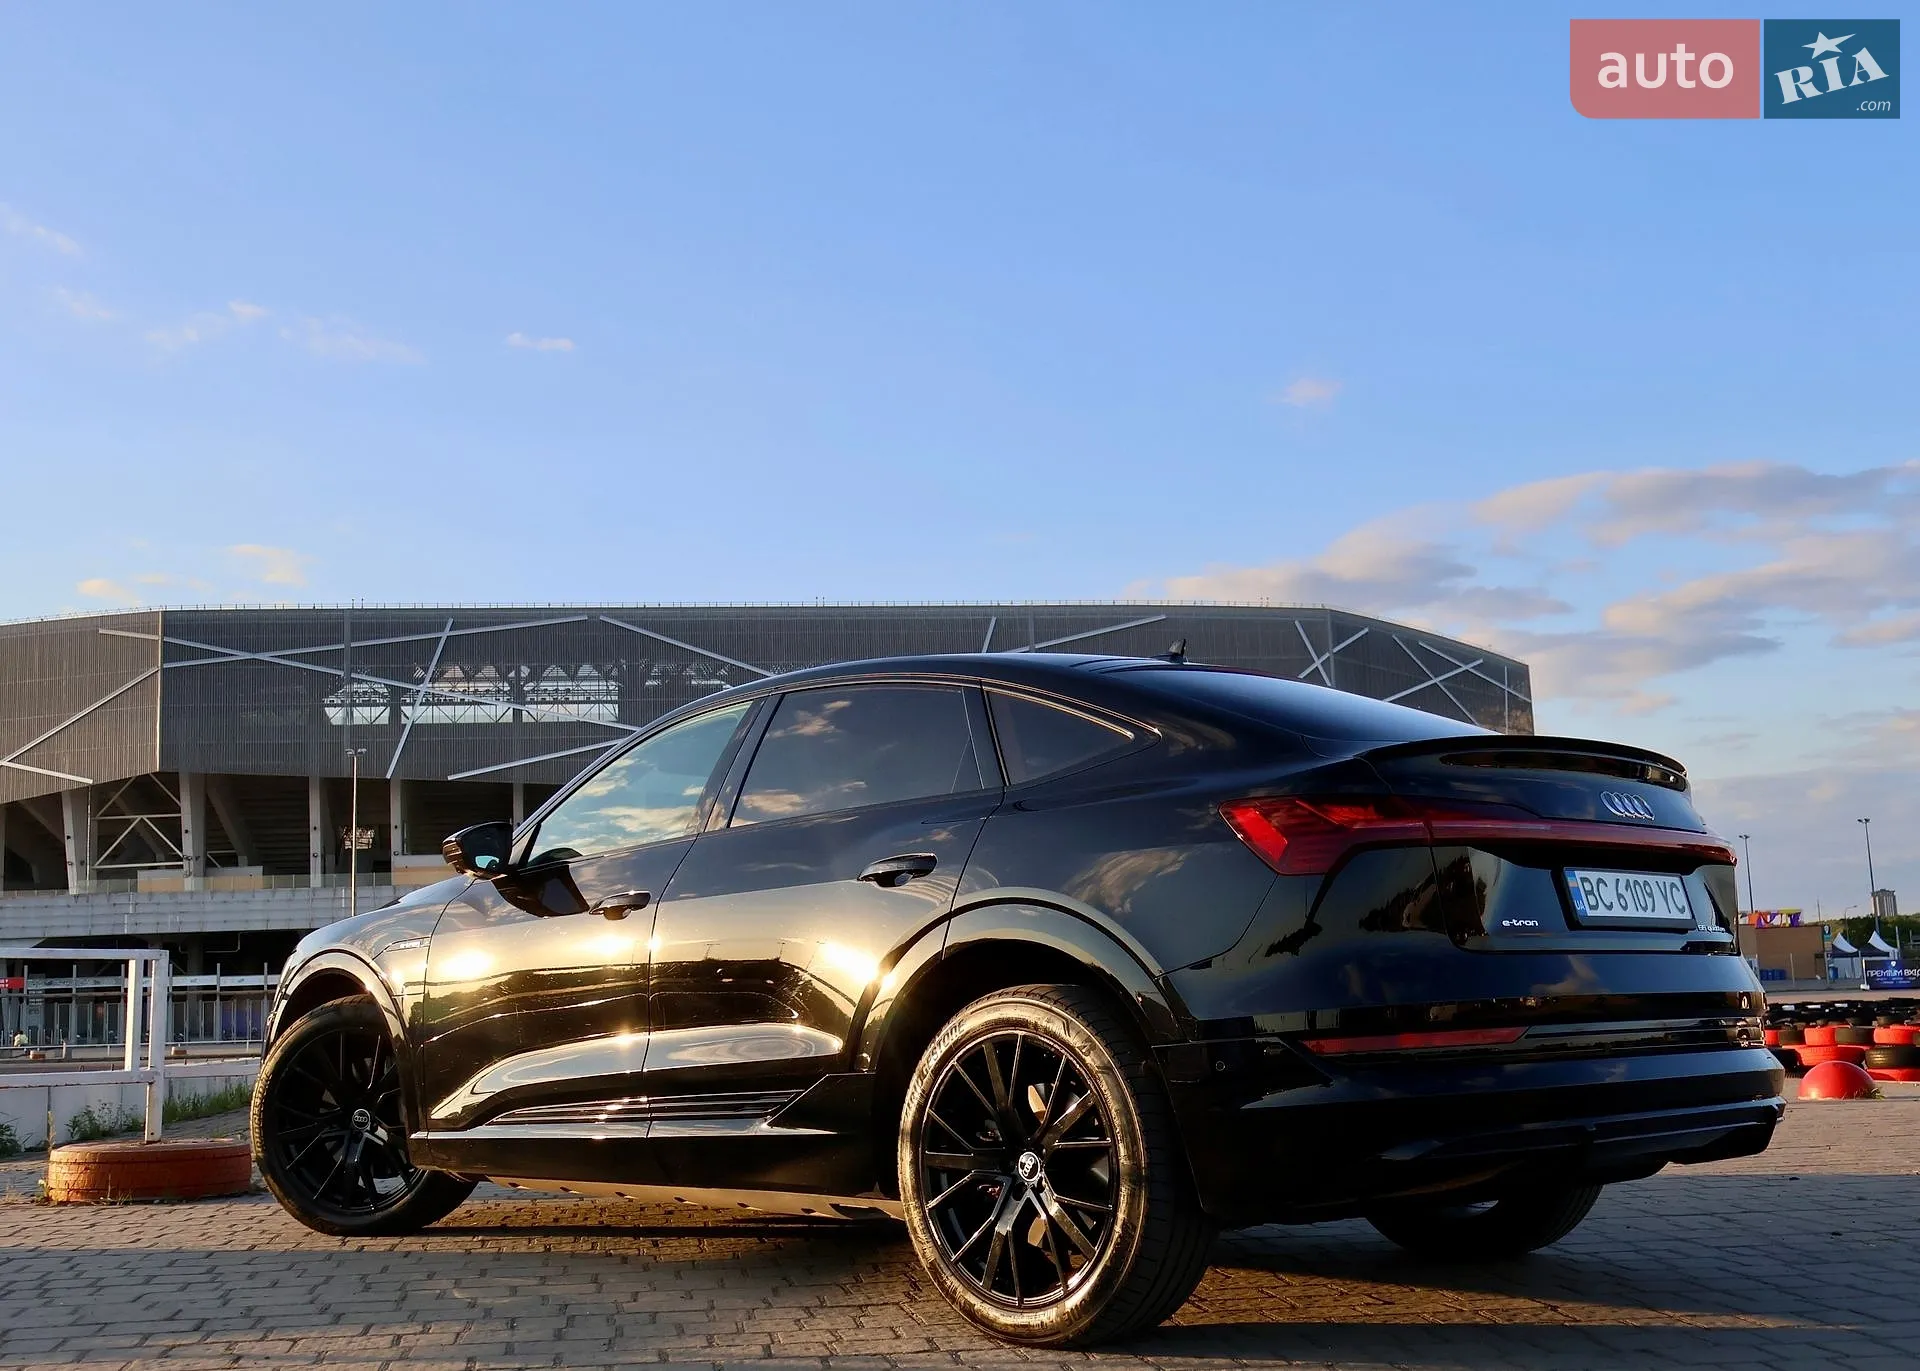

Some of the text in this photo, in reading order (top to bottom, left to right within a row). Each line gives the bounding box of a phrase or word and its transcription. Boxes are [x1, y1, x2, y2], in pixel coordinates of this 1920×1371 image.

[1580, 877, 1686, 914] BC 6109 YC
[1502, 919, 1539, 927] e-tron
